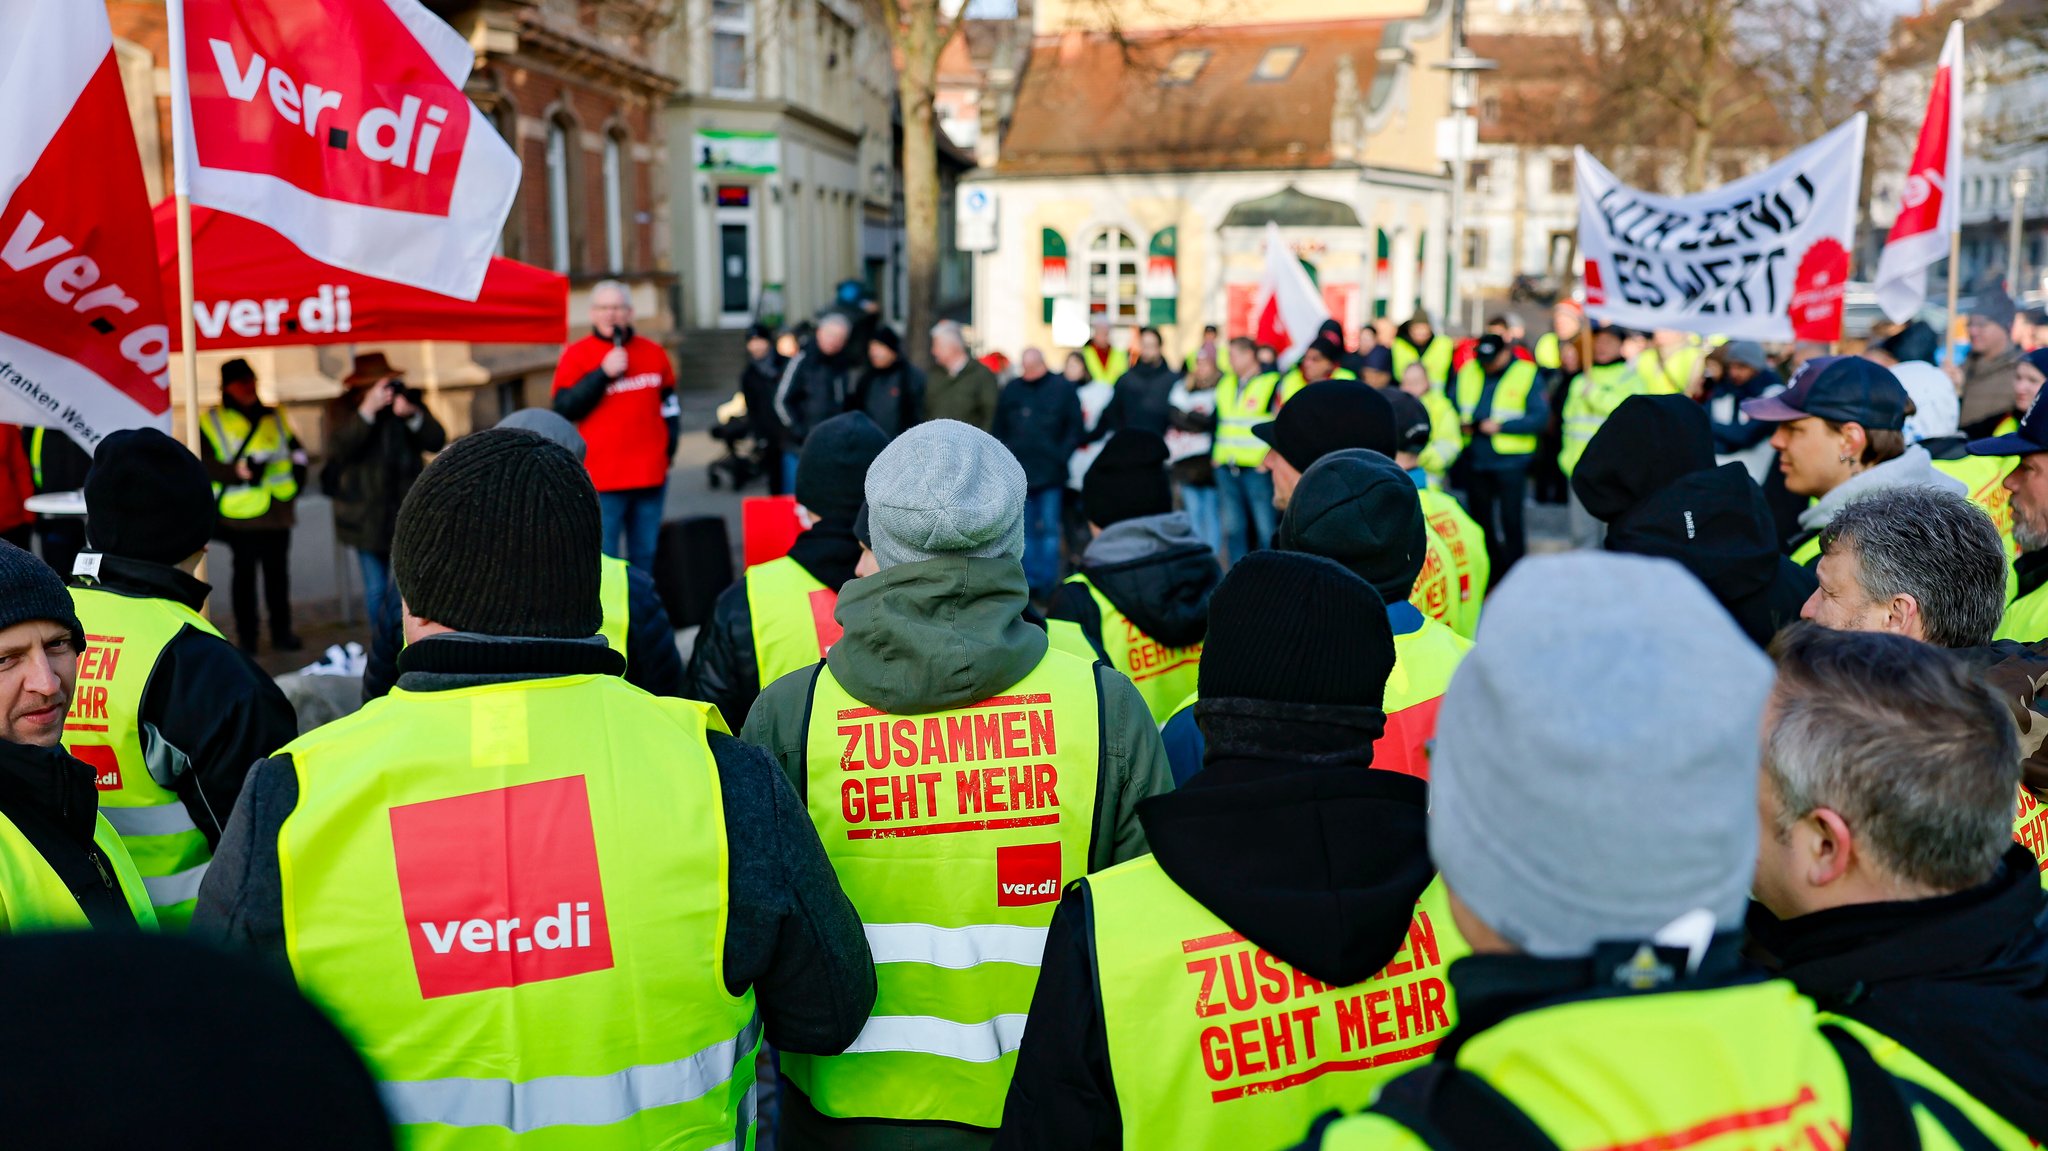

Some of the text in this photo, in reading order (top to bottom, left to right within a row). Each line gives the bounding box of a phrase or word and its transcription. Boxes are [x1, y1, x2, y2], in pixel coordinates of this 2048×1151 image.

[208, 37, 449, 174] ver.di
[193, 284, 352, 338] ver.di
[1612, 251, 1665, 308] ES
[1664, 247, 1785, 314] WERT
[837, 709, 1057, 771] ZUSAMMEN
[841, 763, 1060, 824] GEHT MEHR
[1002, 879, 1057, 896] ver.di
[420, 901, 591, 954] ver.di
[1200, 977, 1450, 1082] GEHT MEHR
